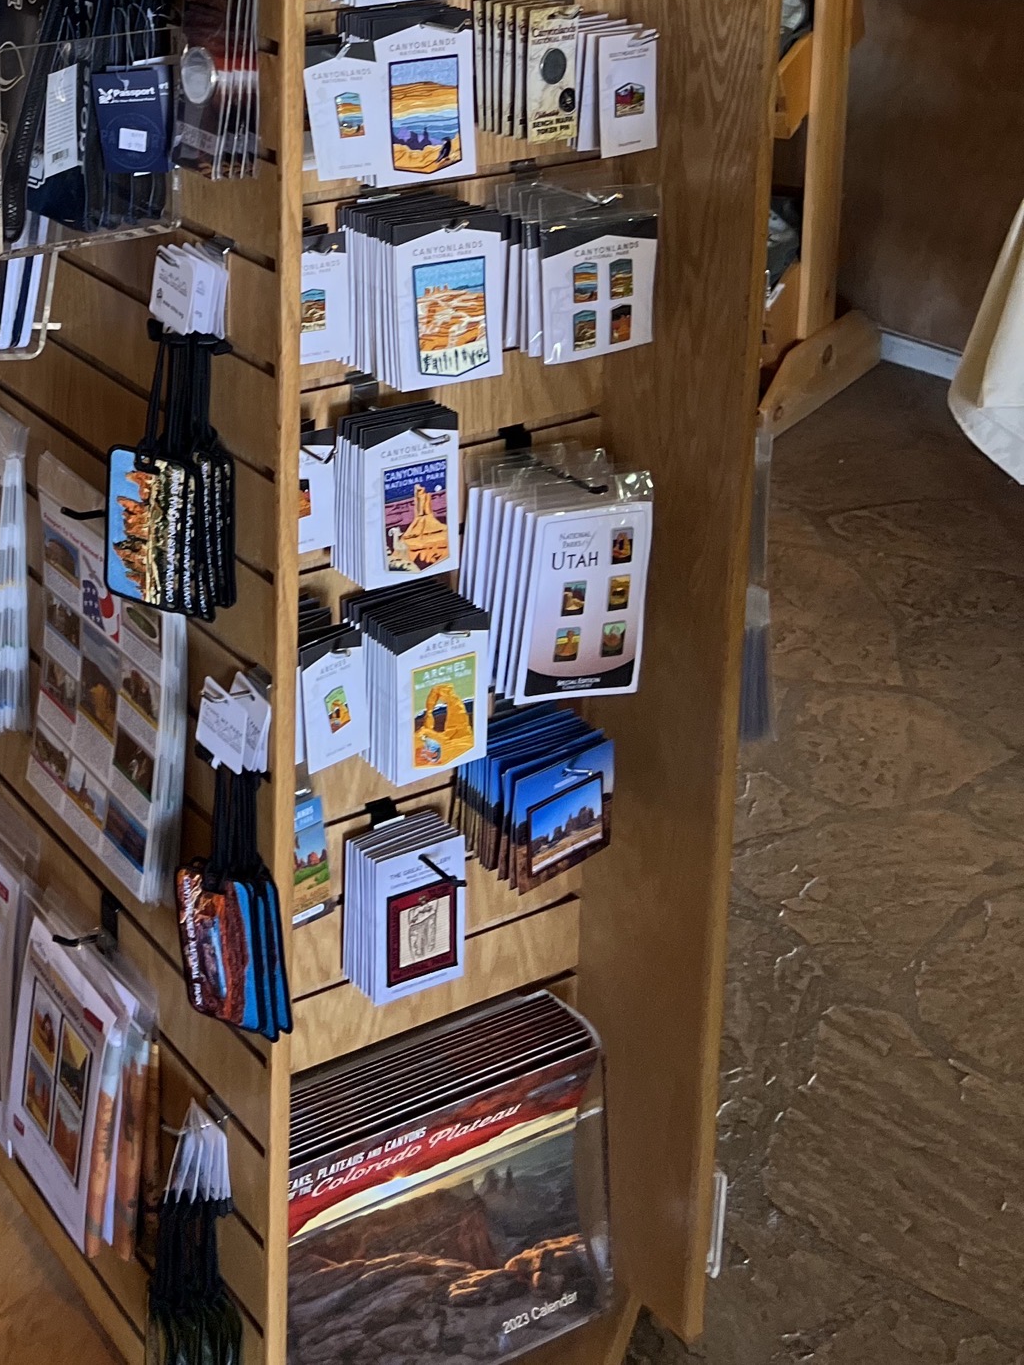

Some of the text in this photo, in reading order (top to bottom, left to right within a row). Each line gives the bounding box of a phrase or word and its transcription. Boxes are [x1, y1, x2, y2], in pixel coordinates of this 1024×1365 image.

[389, 37, 457, 52] CANYONLANDS
[113, 87, 155, 98] Passport
[532, 120, 554, 129] BENCH
[412, 240, 484, 257] CANYONLANDS
[574, 241, 640, 258] CANYONLANDS
[380, 443, 442, 459] CANYONLAN
[385, 461, 447, 483] CANYONLANDS
[385, 471, 445, 490] NATIONAL PARK
[552, 551, 599, 571] UTAH
[422, 660, 466, 681] ARCHES
[288, 1126, 428, 1193] EAKS, PLATEAUS AND CANYONS
[311, 1144, 423, 1198] Colorado
[428, 1102, 522, 1149] Plateau
[502, 1291, 578, 1334] 2023 Calendar
